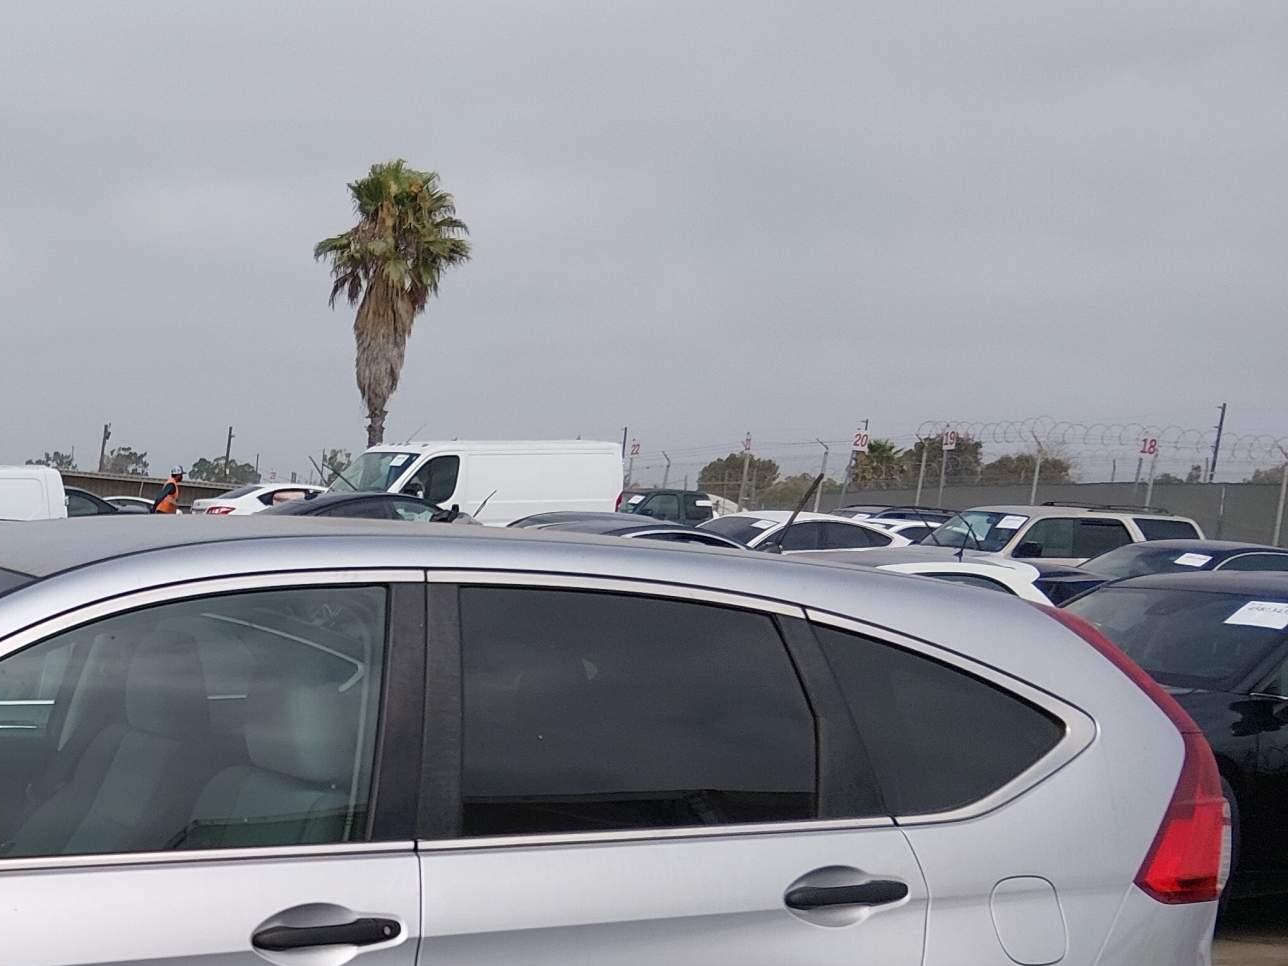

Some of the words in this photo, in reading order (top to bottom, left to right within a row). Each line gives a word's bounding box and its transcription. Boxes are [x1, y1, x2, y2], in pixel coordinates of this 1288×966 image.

[853, 433, 869, 447] 20
[943, 431, 956, 446] 19
[1140, 438, 1157, 455] 18
